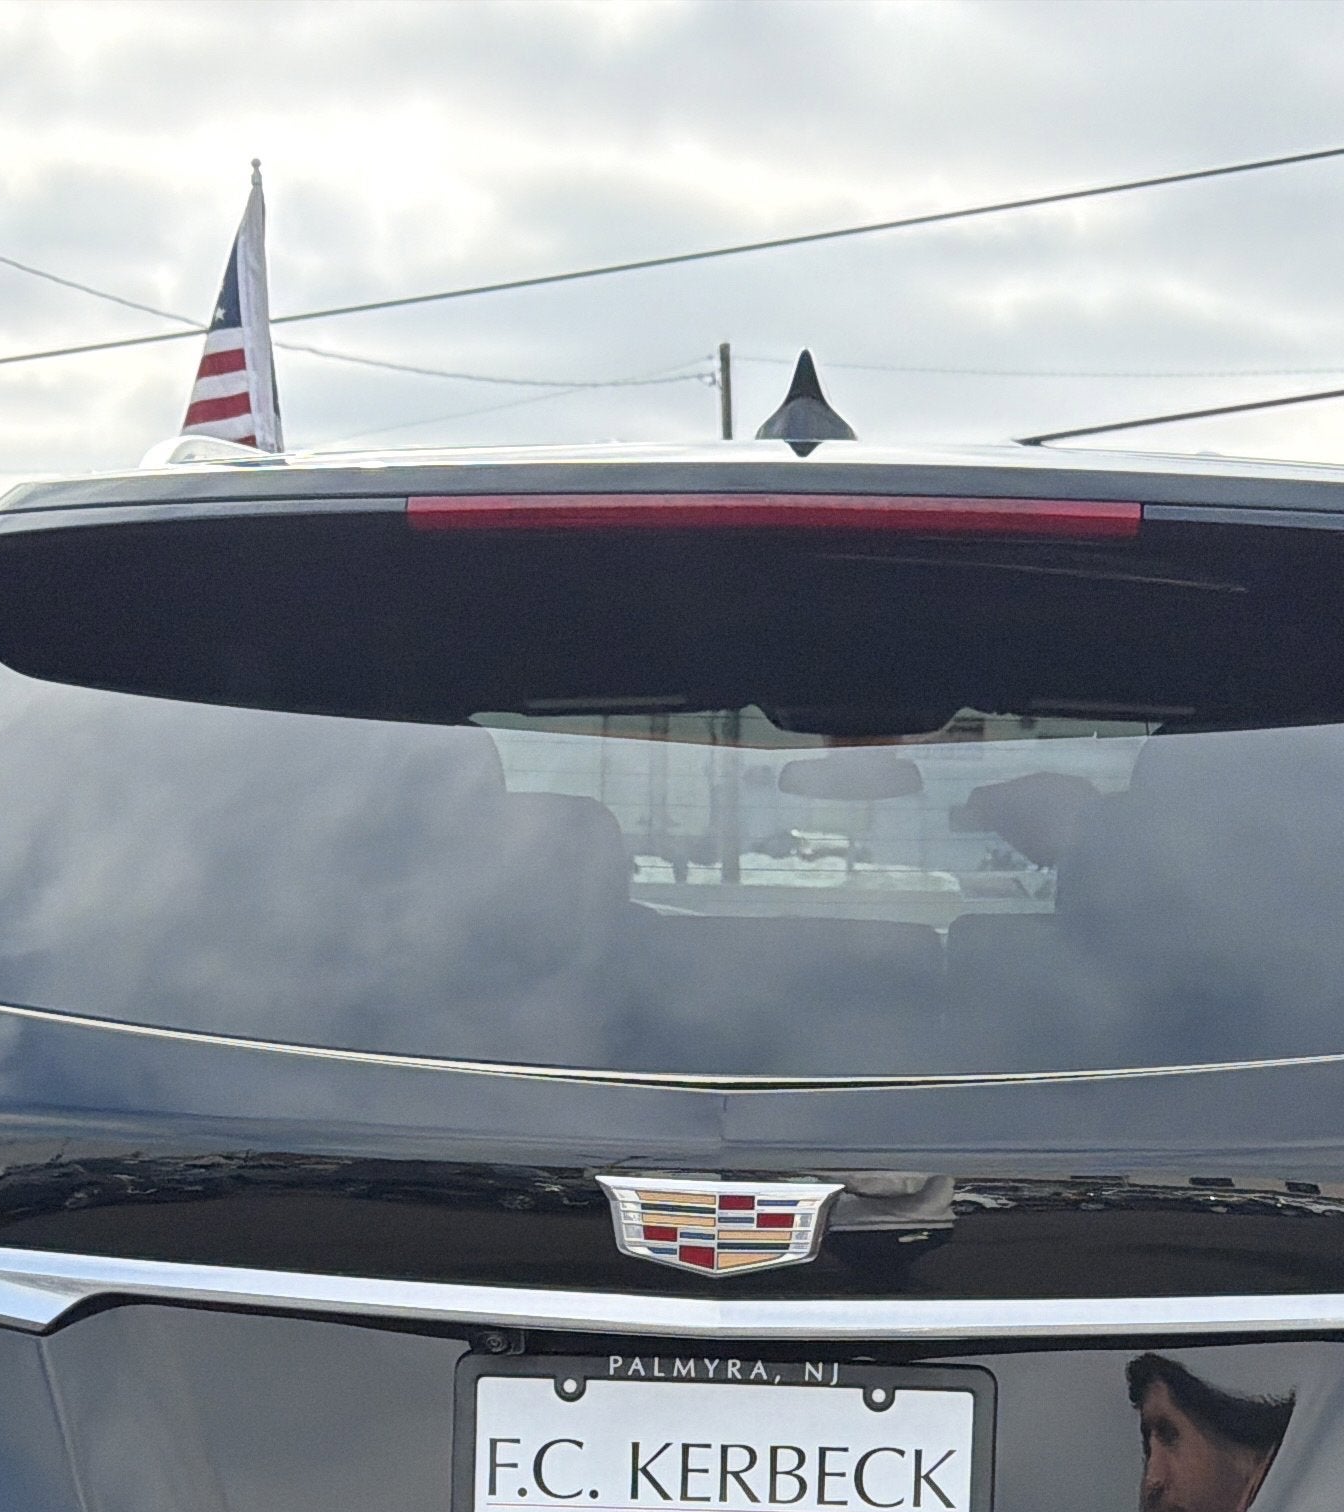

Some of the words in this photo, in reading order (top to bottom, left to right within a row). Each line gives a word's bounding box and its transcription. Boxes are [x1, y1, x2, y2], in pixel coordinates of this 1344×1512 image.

[608, 1355, 781, 1385] PALMYRA,
[804, 1362, 839, 1385] NJ
[488, 1437, 600, 1500] F.C.
[630, 1441, 957, 1510] KERBECK
